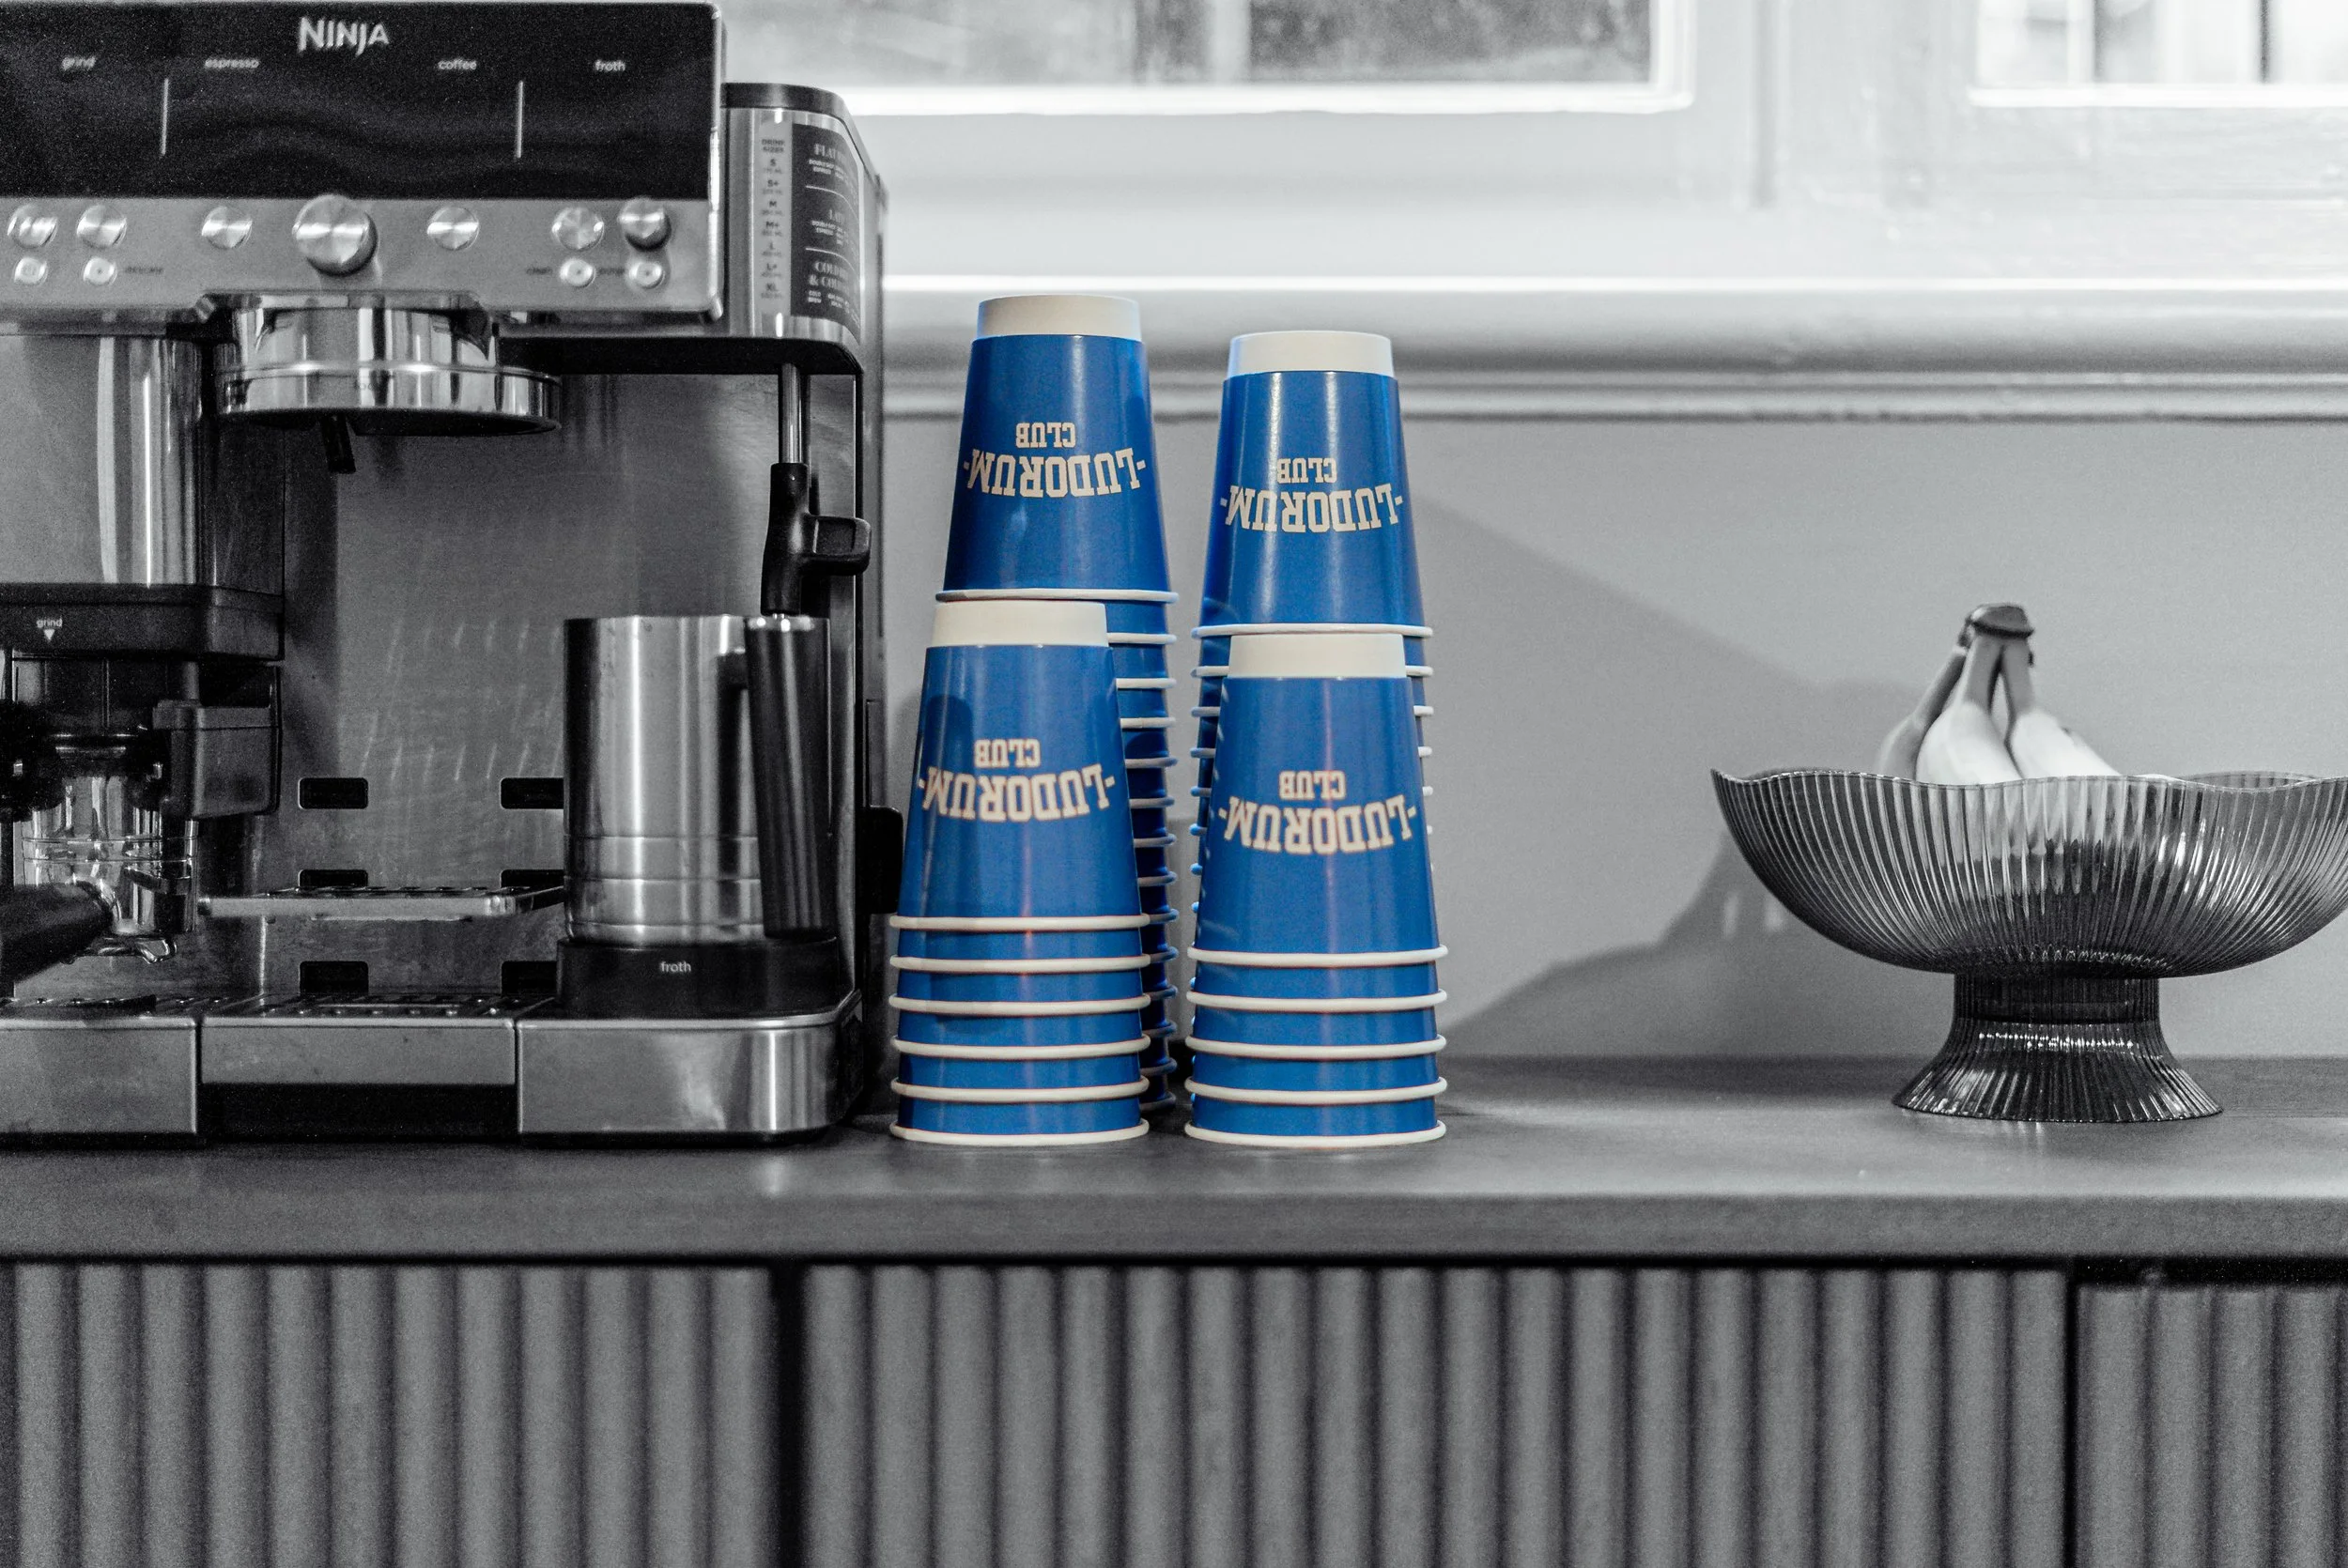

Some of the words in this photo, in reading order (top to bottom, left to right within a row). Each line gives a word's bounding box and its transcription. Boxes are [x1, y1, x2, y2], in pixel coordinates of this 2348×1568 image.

[298, 17, 390, 56] NINJA
[205, 58, 259, 69] espresso
[438, 58, 477, 70] coffee
[595, 58, 626, 71] froth
[1015, 423, 1076, 448] CLUB
[1277, 457, 1337, 484] CLUB
[36, 617, 63, 628] grind
[974, 738, 1041, 768] CLUB
[1279, 770, 1347, 800] CLUB
[660, 961, 692, 973] froth
